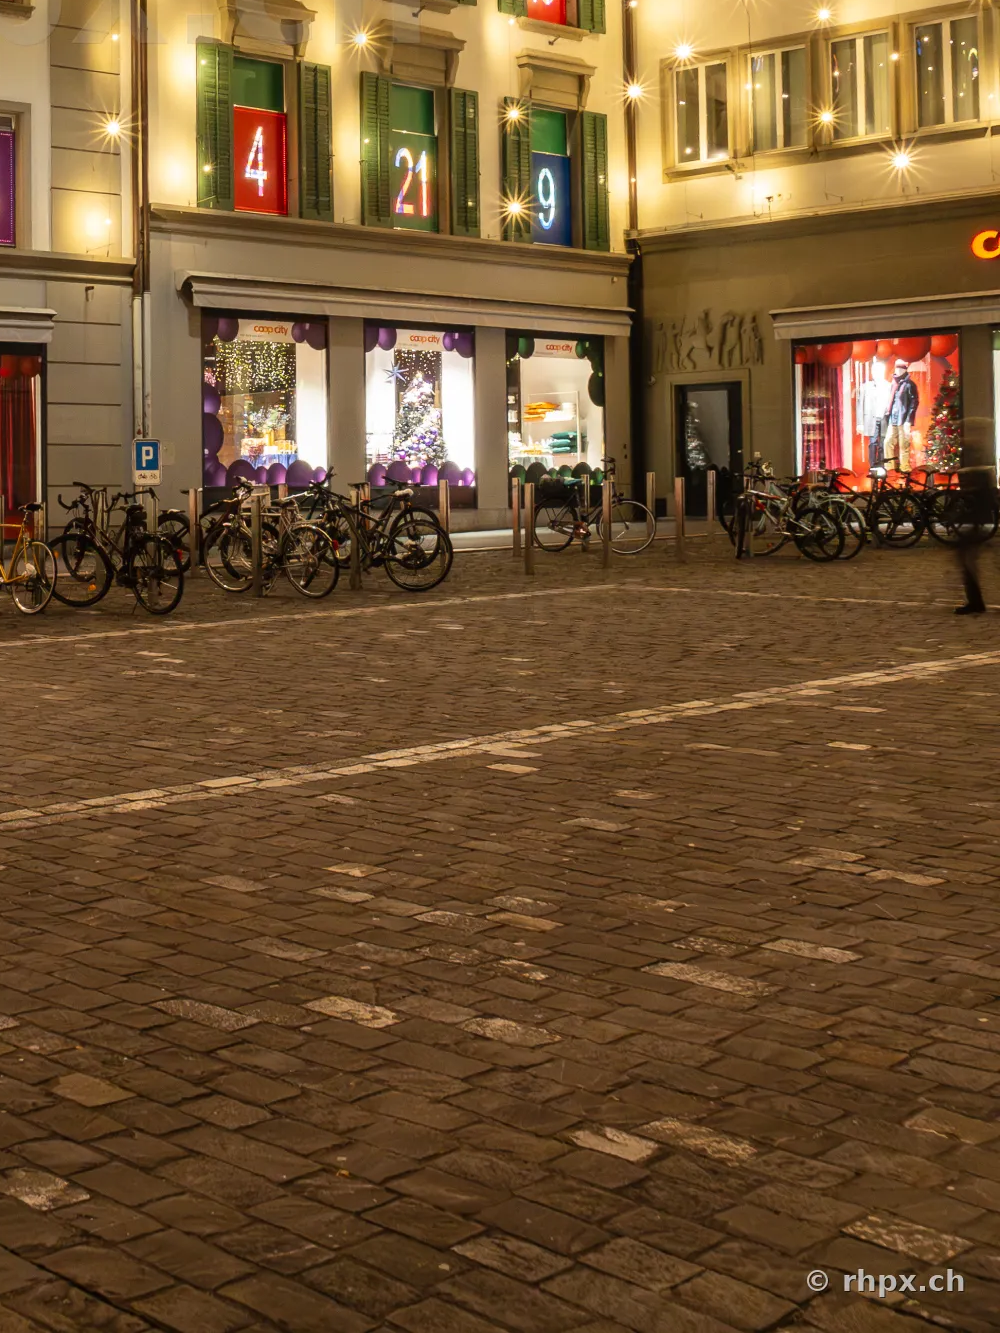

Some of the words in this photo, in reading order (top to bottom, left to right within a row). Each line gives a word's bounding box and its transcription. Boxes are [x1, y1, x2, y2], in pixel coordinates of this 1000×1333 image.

[244, 126, 269, 196] 4
[395, 147, 428, 217] 21
[538, 168, 556, 230] 9
[142, 446, 153, 467] P
